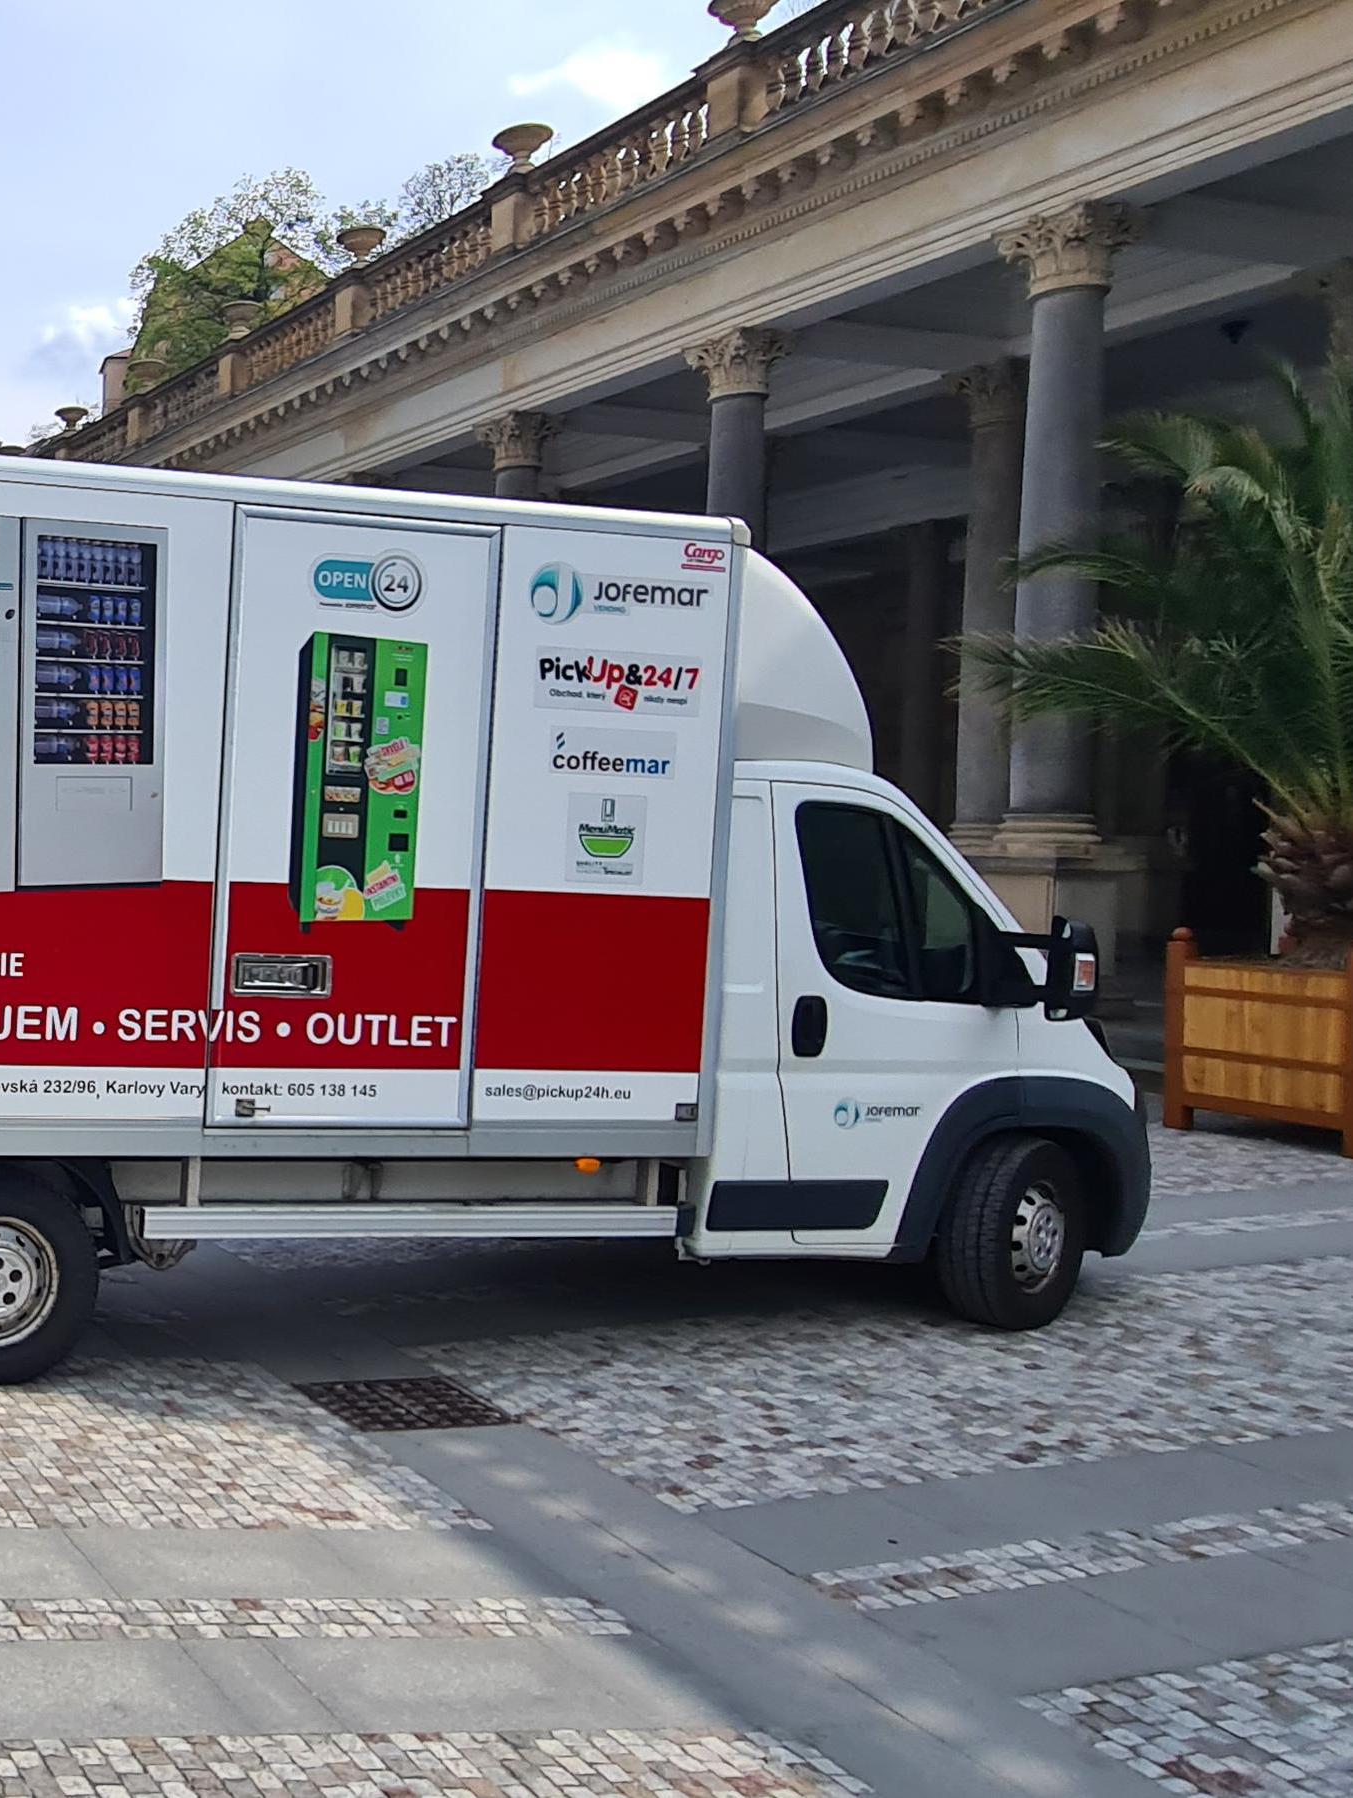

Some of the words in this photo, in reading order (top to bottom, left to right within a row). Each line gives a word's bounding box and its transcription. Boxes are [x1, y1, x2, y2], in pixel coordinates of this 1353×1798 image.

[684, 542, 725, 564] Cargo
[318, 570, 367, 590] OPEN
[383, 574, 409, 593] 24
[593, 581, 709, 607] Jofemar
[539, 656, 700, 690] PickUp&24/7
[552, 751, 670, 774] coffeemar
[117, 1008, 261, 1044] SERVIS
[306, 1012, 458, 1047] OUTLET
[43, 1080, 101, 1099] 232/96,
[106, 1081, 165, 1097] Karlovy
[170, 1082, 206, 1098] Vary
[222, 1081, 283, 1096] kontakt:
[287, 1084, 317, 1097] 605
[320, 1084, 346, 1097] 138
[350, 1085, 377, 1098] 145
[484, 1084, 632, 1101] sales@pickup24h.eu
